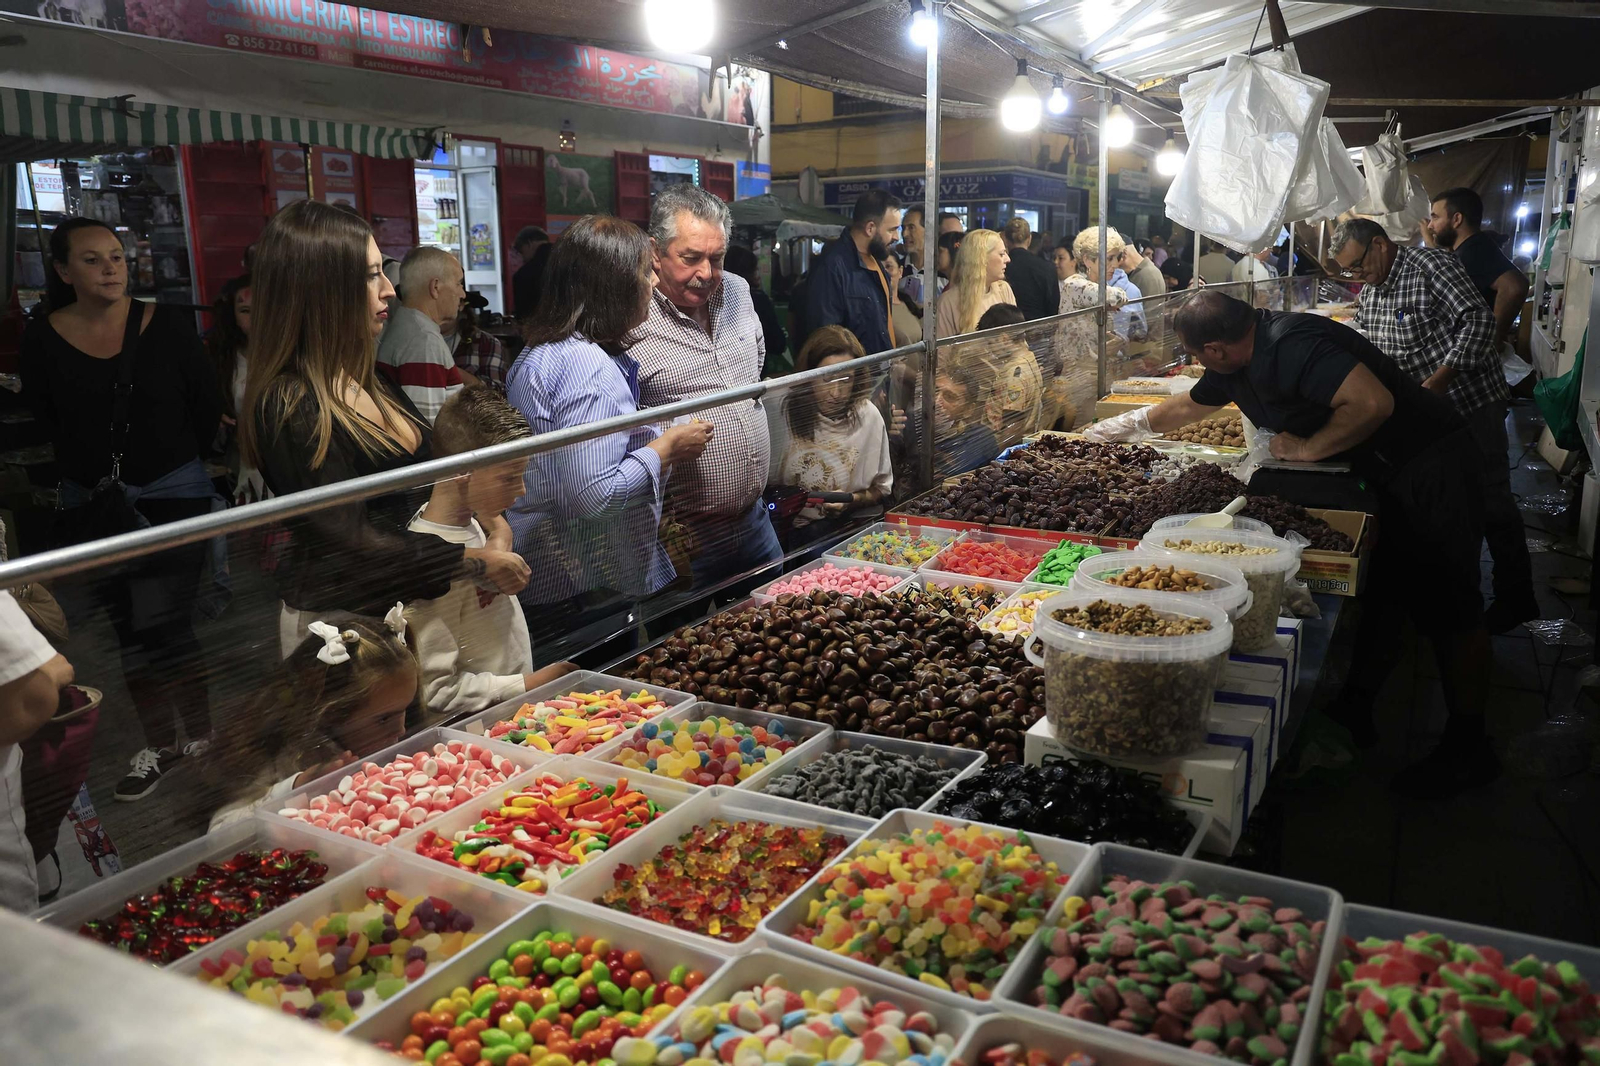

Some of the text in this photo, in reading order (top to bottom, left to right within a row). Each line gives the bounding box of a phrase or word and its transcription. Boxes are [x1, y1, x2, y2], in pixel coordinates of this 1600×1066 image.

[359, 7, 384, 39] EL
[243, 36, 266, 50] 856
[268, 40, 282, 52] 22
[284, 42, 299, 54] 41
[301, 45, 315, 56] 86
[384, 43, 446, 65] MUSULMAN
[839, 183, 870, 193] CASIO
[903, 183, 980, 198] GAVEZ
[1318, 579, 1349, 593] Deglet
